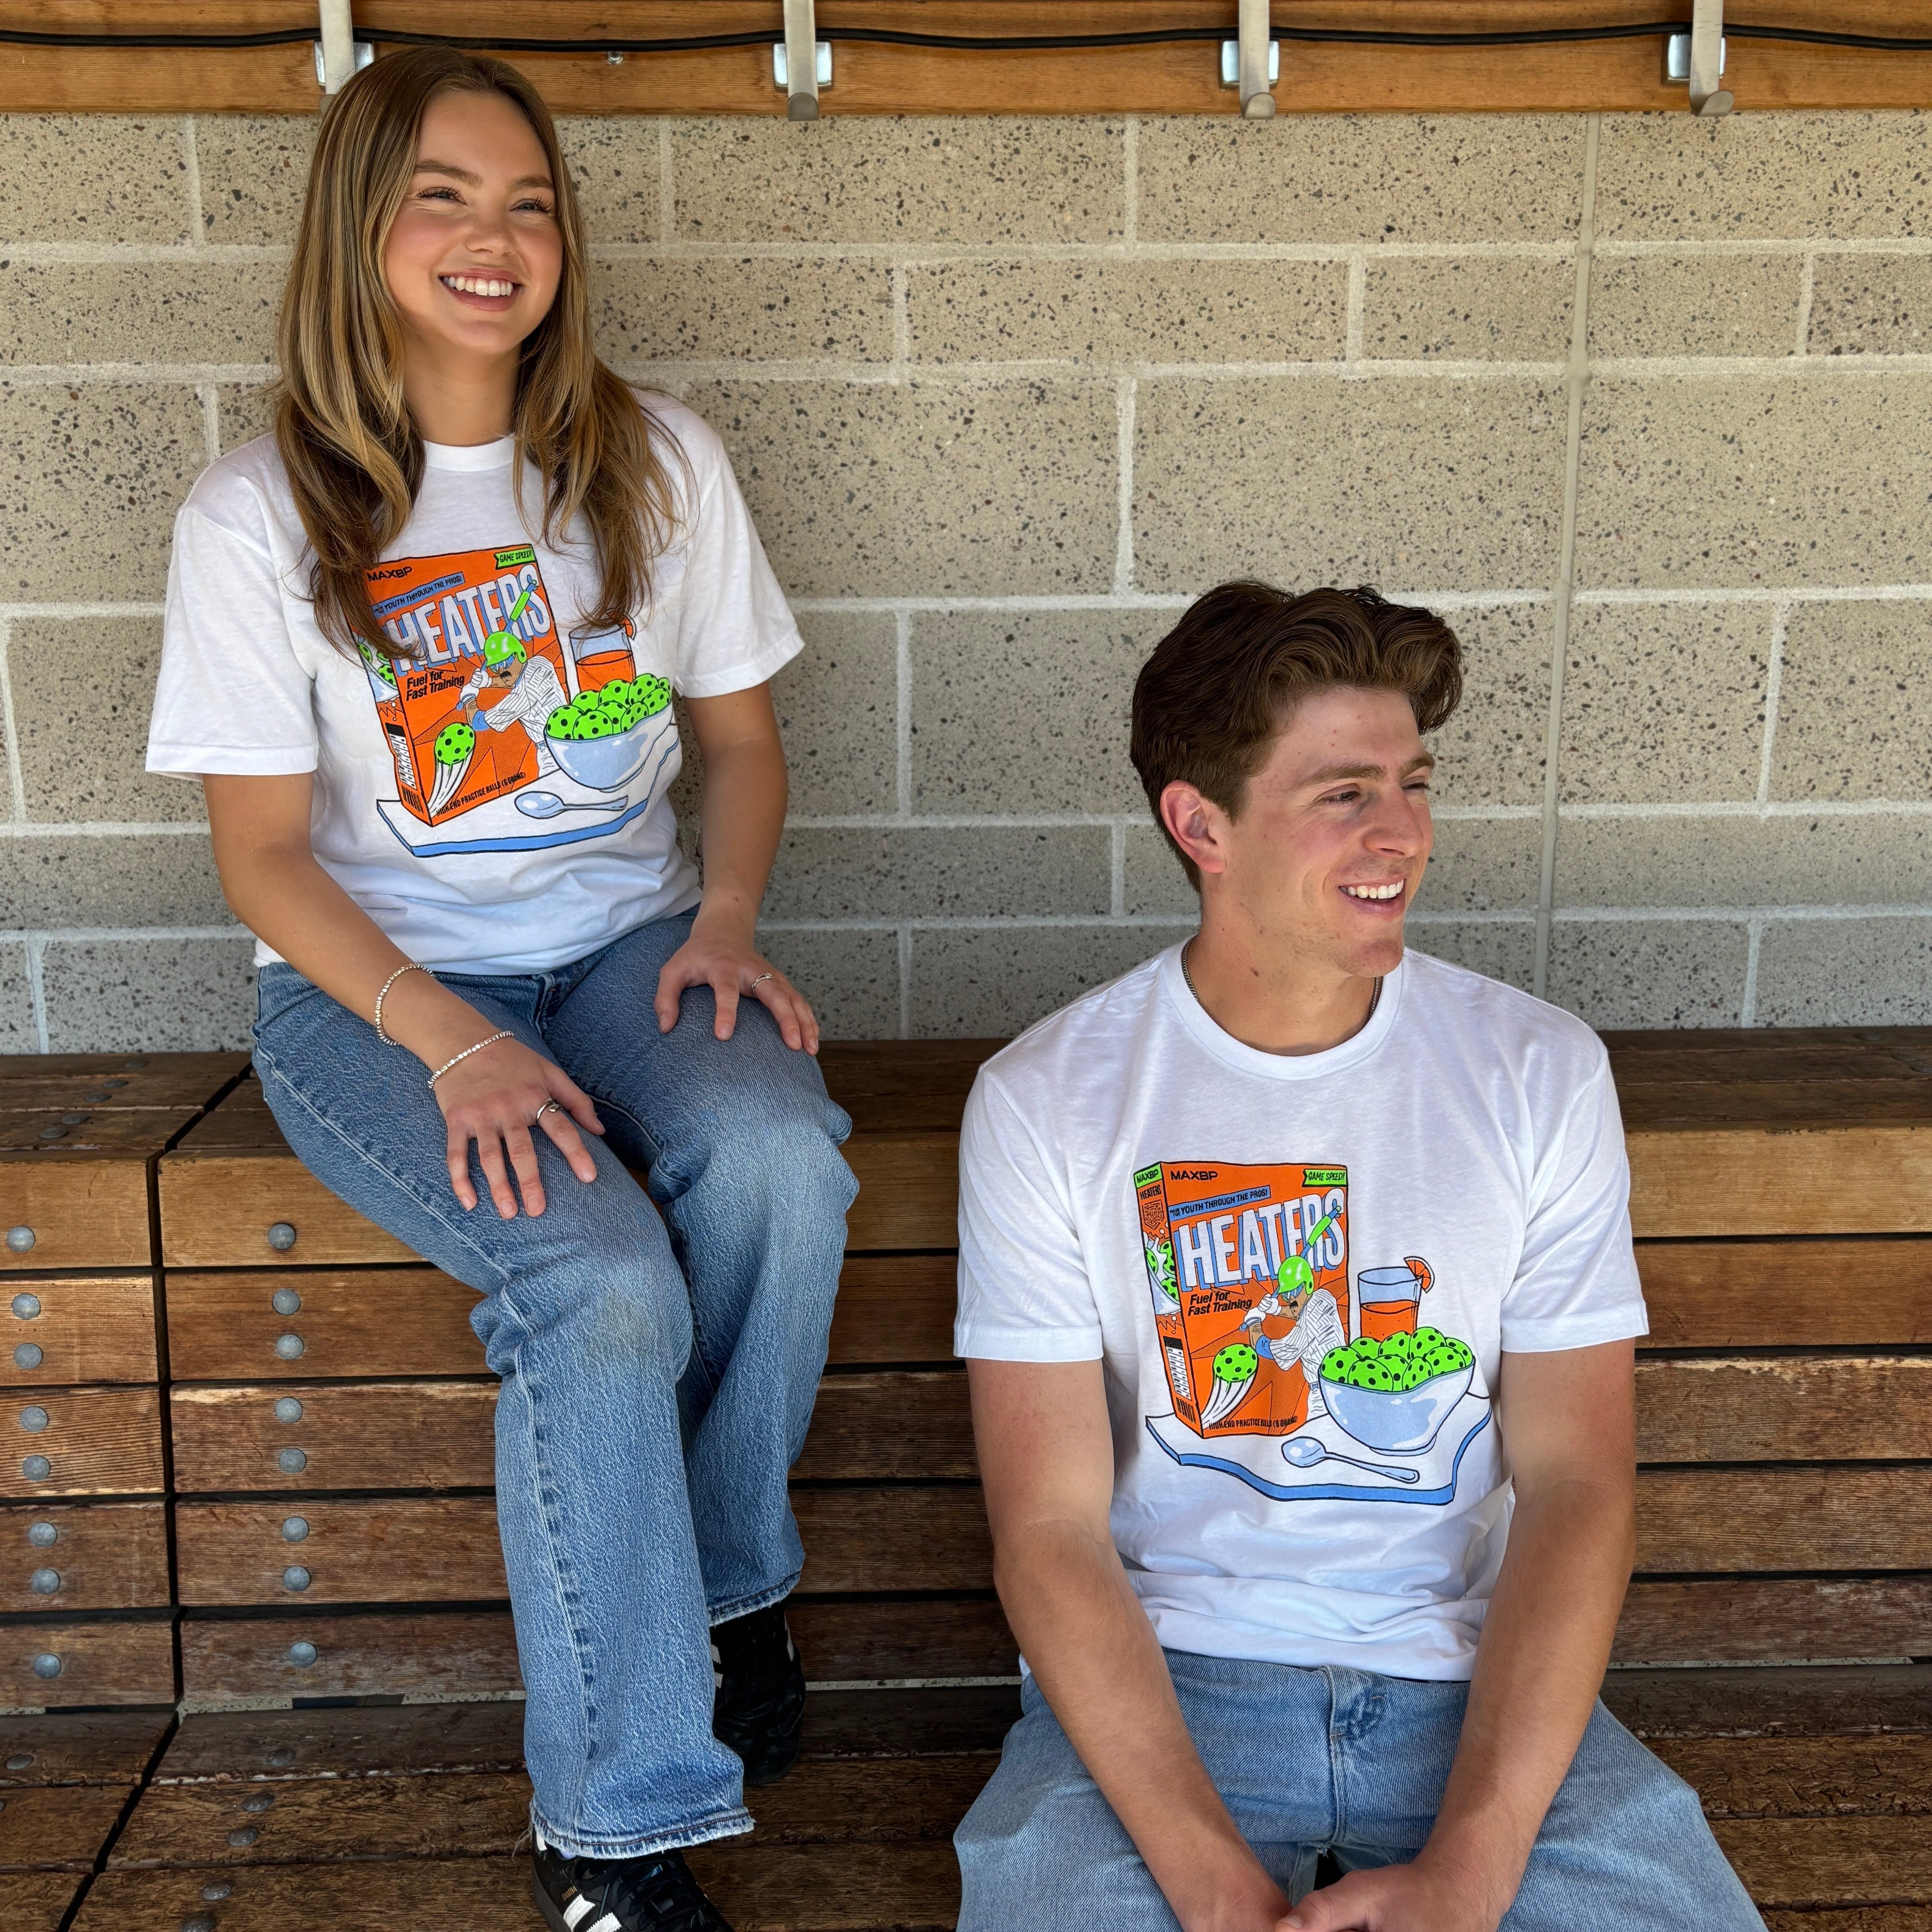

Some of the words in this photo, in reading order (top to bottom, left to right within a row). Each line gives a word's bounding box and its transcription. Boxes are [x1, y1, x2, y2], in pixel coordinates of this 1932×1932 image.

[499, 553, 515, 563] GAME
[366, 566, 413, 582] MAXBP
[384, 598, 405, 611] YOUTH
[406, 585, 434, 603] THROUGH
[434, 580, 445, 589] THE
[407, 672, 428, 690] Fuel
[430, 670, 444, 682] for
[406, 685, 428, 702] Fast
[429, 676, 465, 694] Training
[460, 787, 487, 805] PRACTICE
[1136, 1168, 1159, 1184] MAXBP
[1170, 1170, 1218, 1181] MAXBP
[1308, 1171, 1325, 1181] GAME
[1325, 1171, 1345, 1181] SPEED!
[1140, 1184, 1162, 1201] HEATERS
[1181, 1202, 1204, 1215] YOUTH
[1204, 1196, 1236, 1210] THROUGH
[1236, 1192, 1249, 1202] THE
[1250, 1188, 1268, 1199] PROS!
[1190, 1292, 1214, 1306] Fuel
[1215, 1290, 1230, 1302] for
[1187, 1303, 1211, 1317] Fast
[1213, 1298, 1253, 1313] Training
[1236, 1418, 1260, 1427] PRACTICE
